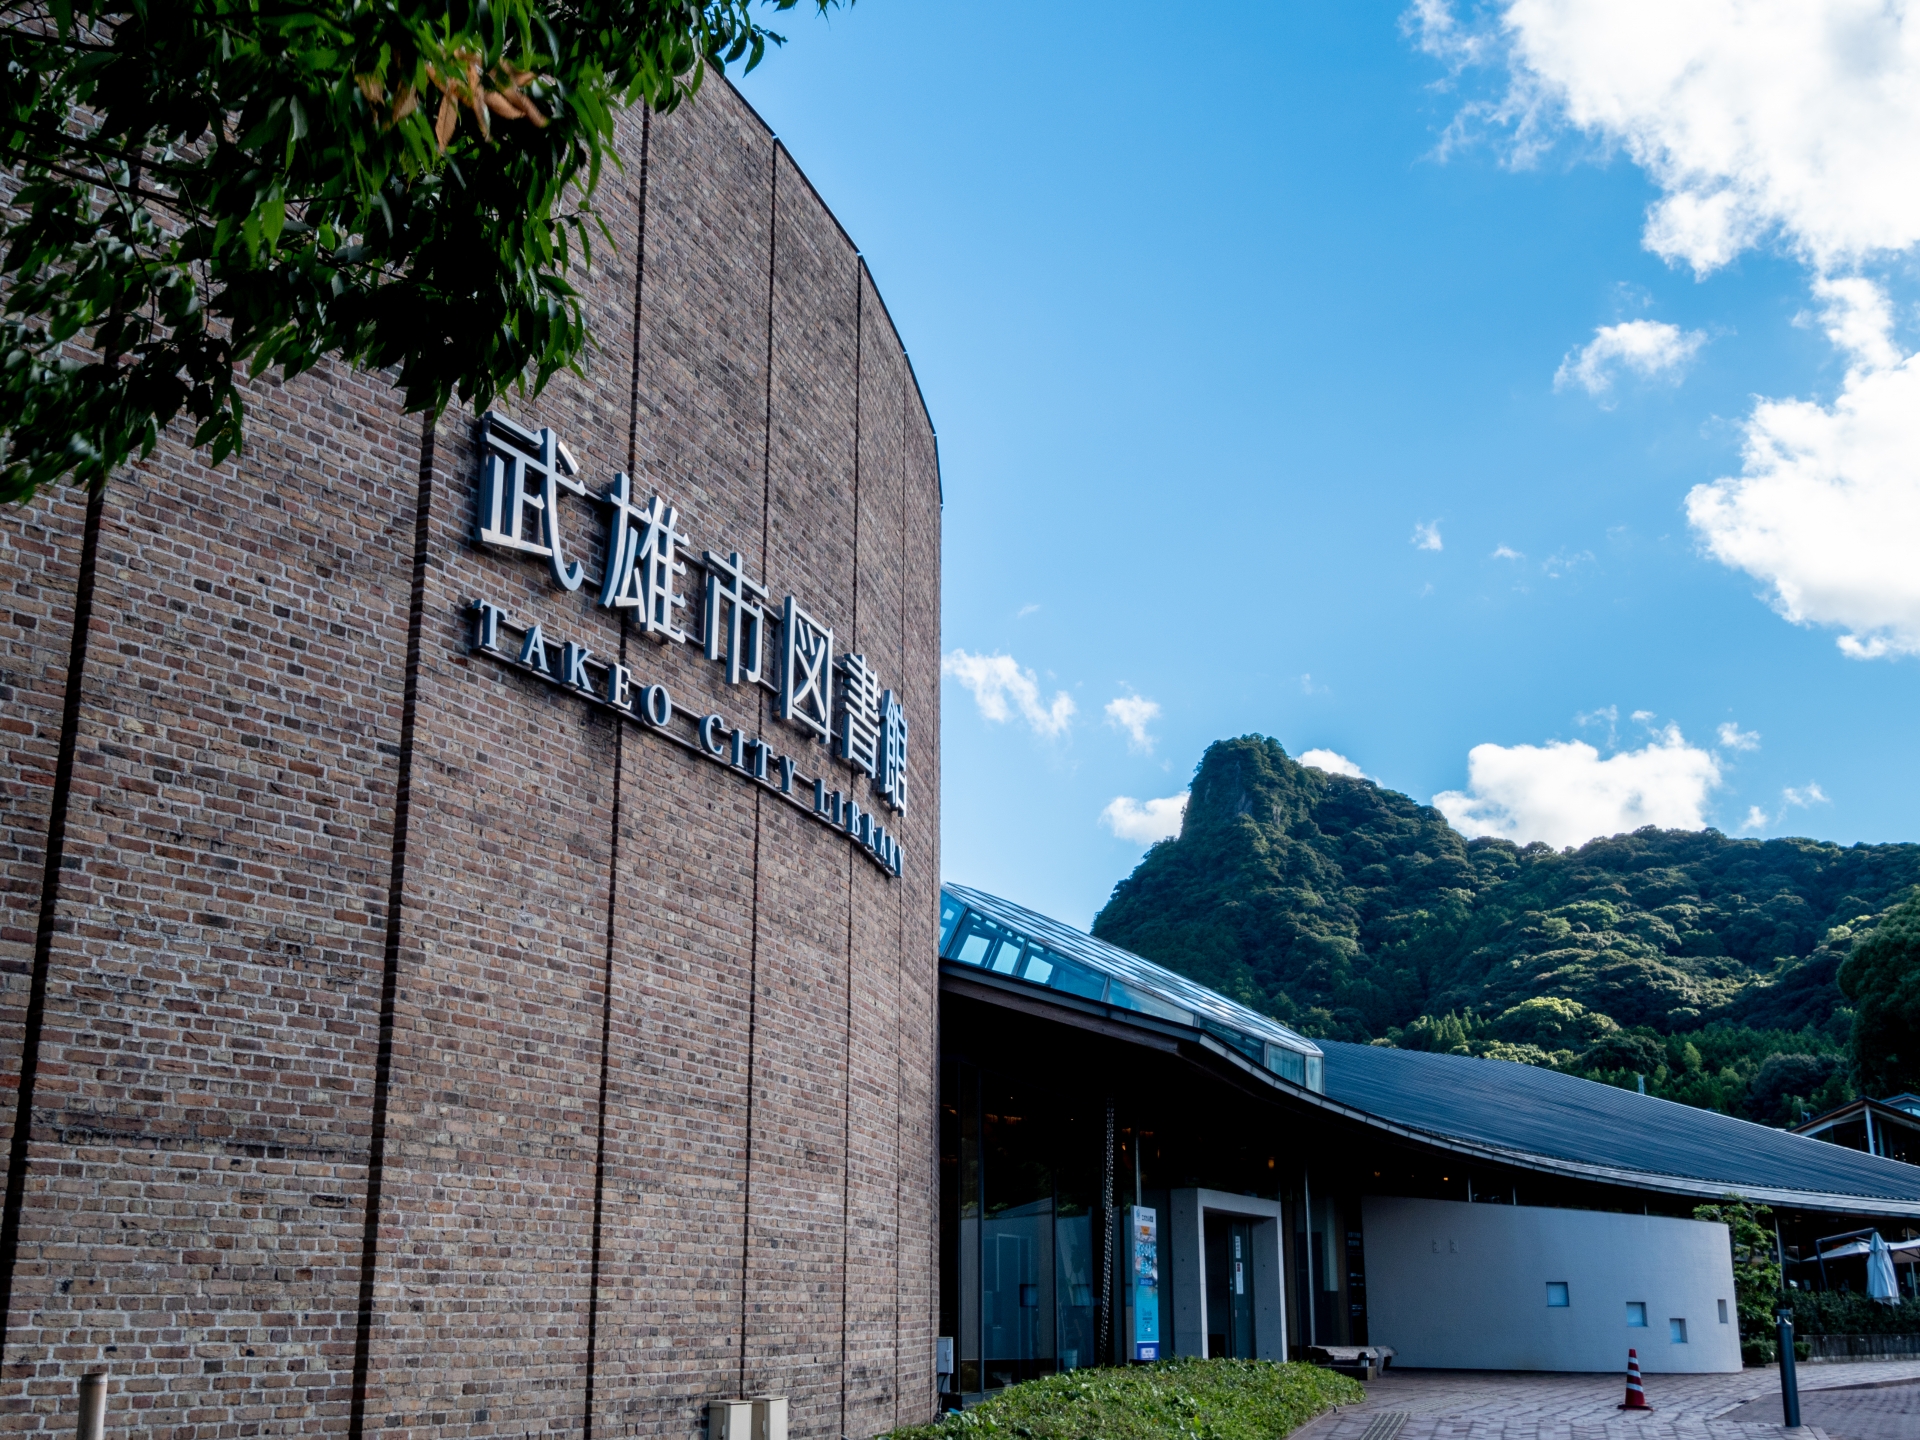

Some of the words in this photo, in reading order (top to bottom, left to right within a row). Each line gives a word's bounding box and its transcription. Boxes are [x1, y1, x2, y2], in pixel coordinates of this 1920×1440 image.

[474, 598, 672, 728] TAKEO
[699, 713, 797, 795] CITY
[814, 778, 906, 878] LIBRARY
[479, 410, 908, 818] 武雄市図書館
